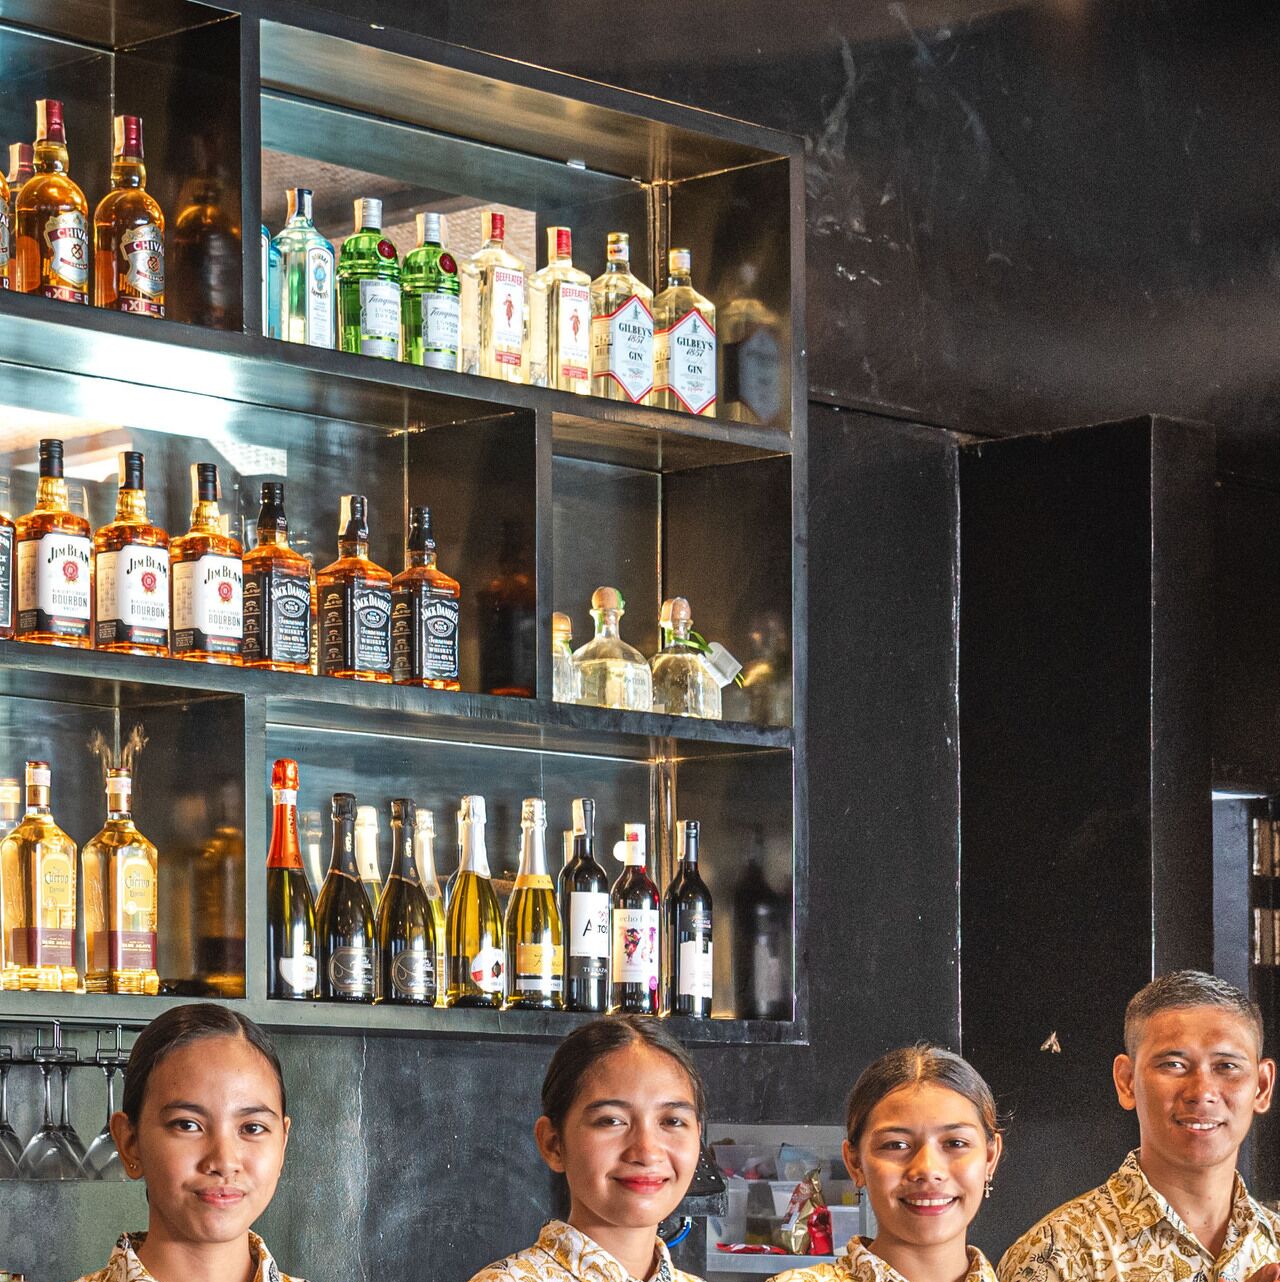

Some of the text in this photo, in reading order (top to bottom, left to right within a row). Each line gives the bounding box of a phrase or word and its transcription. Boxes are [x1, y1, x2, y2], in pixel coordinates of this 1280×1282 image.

[57, 228, 89, 244] CHIVA
[133, 240, 165, 257] CHIVA
[495, 271, 523, 285] BEEFEATER
[53, 288, 70, 300] XII
[561, 287, 589, 300] BEEFEATER
[129, 300, 146, 312] XII
[618, 322, 653, 337] GILBEY'S
[677, 336, 713, 351] GILBEY'S
[628, 351, 643, 361] GIN
[687, 365, 703, 375] GIN
[47, 543, 90, 568] JIM BEAM
[126, 555, 168, 579] JIM BEAM
[204, 565, 242, 588] JIM BEAM
[52, 593, 88, 607] BOURBON
[271, 585, 287, 601] JACK
[131, 602, 165, 619] BOURBON
[353, 596, 369, 611] JACK
[208, 613, 241, 627] BOURBON
[421, 606, 436, 620] JACK
[279, 627, 305, 636] WHISKEY
[361, 638, 386, 646] WHISKEY
[429, 647, 454, 655] WHISKEY
